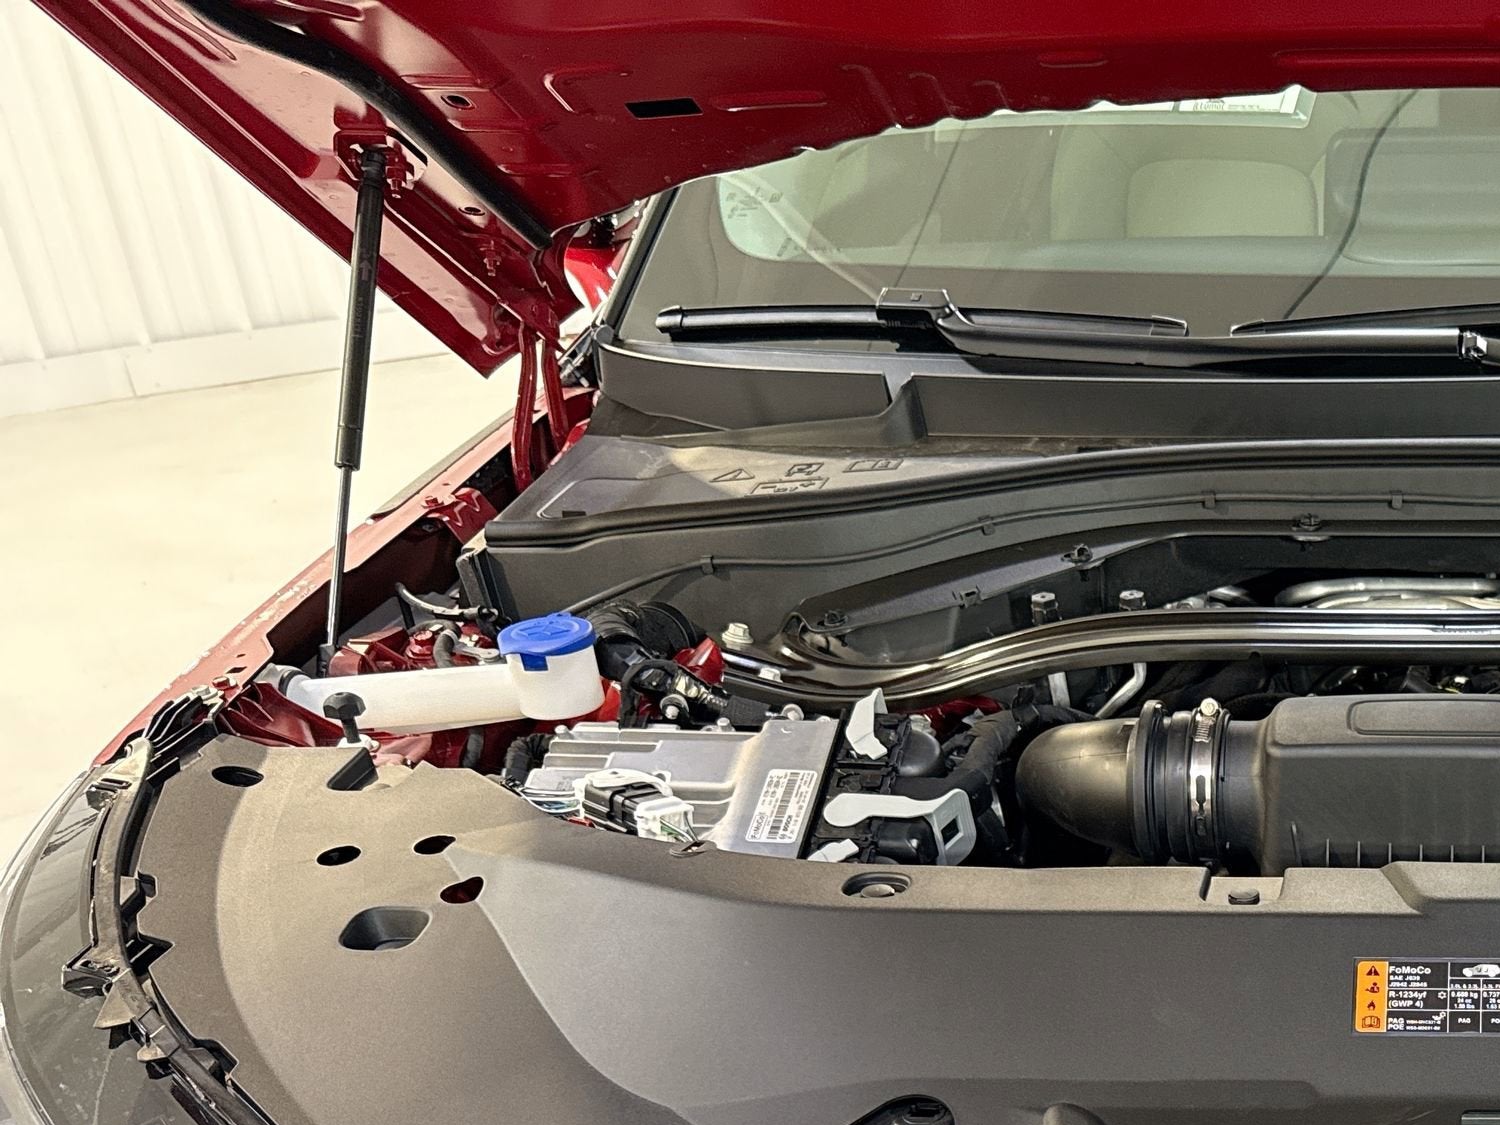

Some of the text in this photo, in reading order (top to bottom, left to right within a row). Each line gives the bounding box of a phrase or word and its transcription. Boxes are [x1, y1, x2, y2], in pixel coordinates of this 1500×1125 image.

[1389, 966, 1432, 974] FoMoCo
[1388, 991, 1427, 1000] R-1234yf
[1469, 991, 1479, 999] kg
[1388, 1000, 1424, 1009] (GWP 4)
